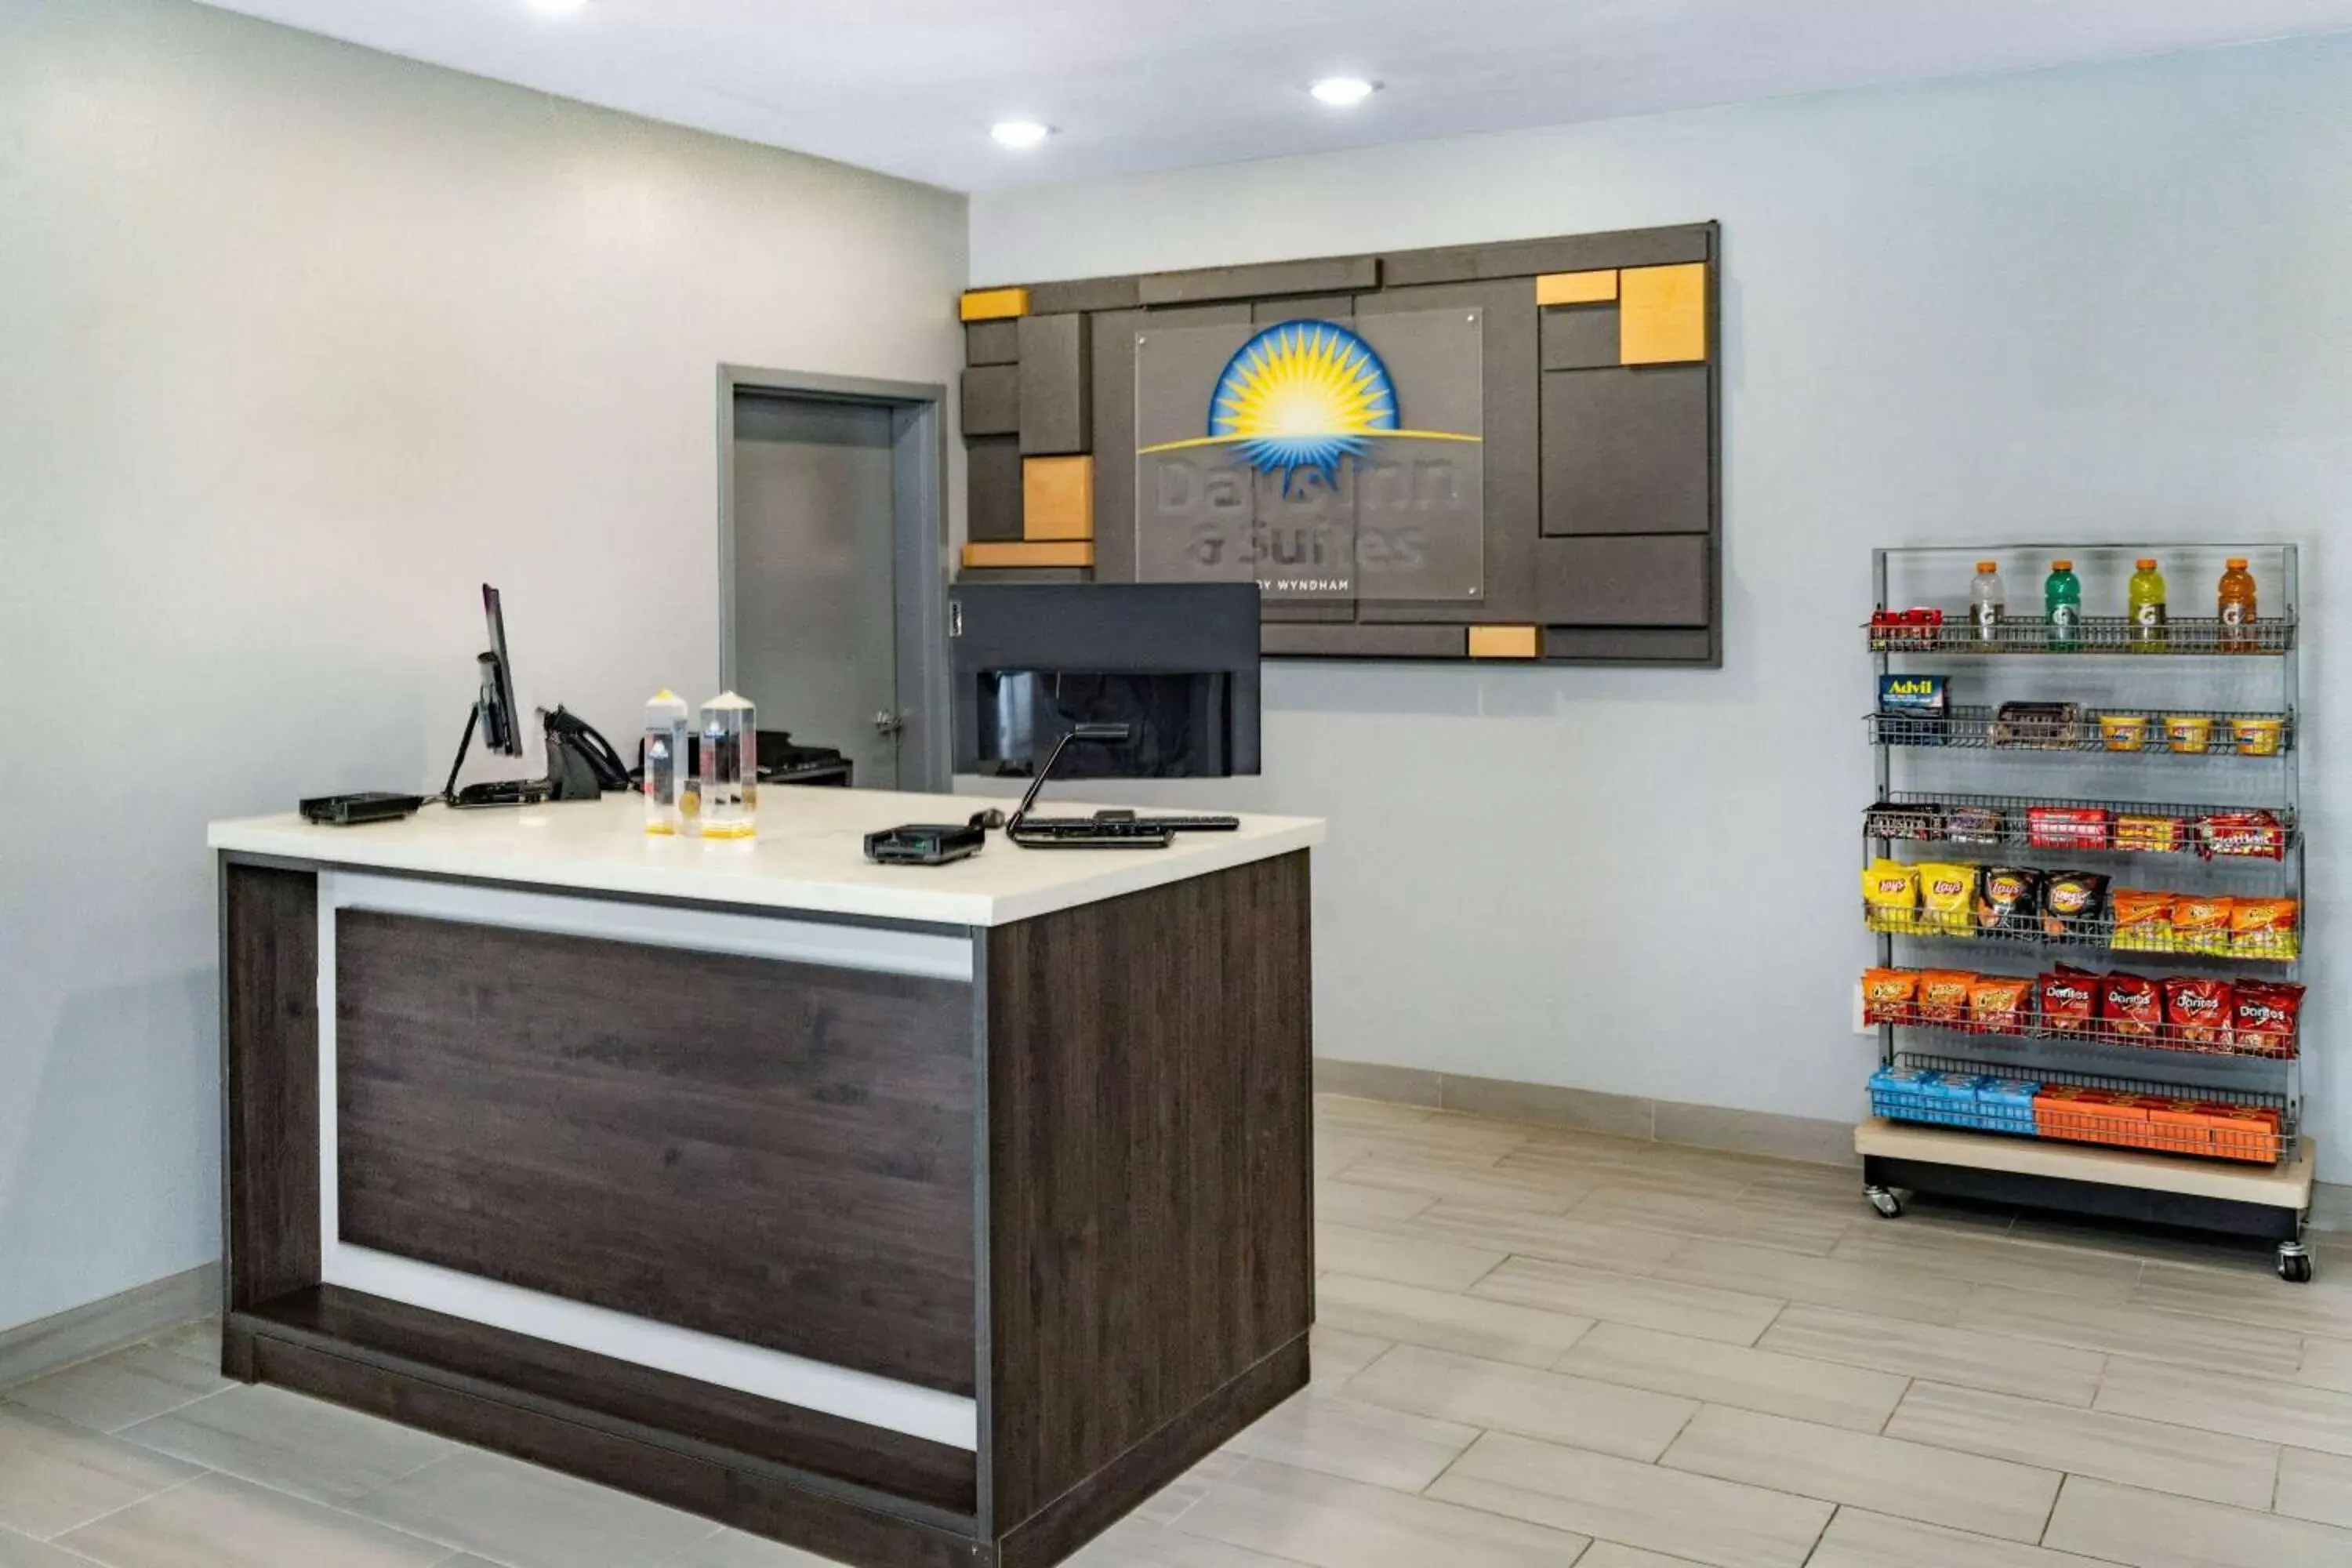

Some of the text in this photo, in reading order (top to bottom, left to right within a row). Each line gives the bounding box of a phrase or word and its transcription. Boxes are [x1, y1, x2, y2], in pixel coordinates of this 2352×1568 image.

[1277, 579, 1348, 591] WYNDHAM
[1889, 680, 1933, 695] Advil
[2045, 986, 2089, 1000] Doritos
[2108, 990, 2151, 1004] Doritos
[2176, 995, 2219, 1009] Doritos
[2239, 1006, 2285, 1020] Doritos
